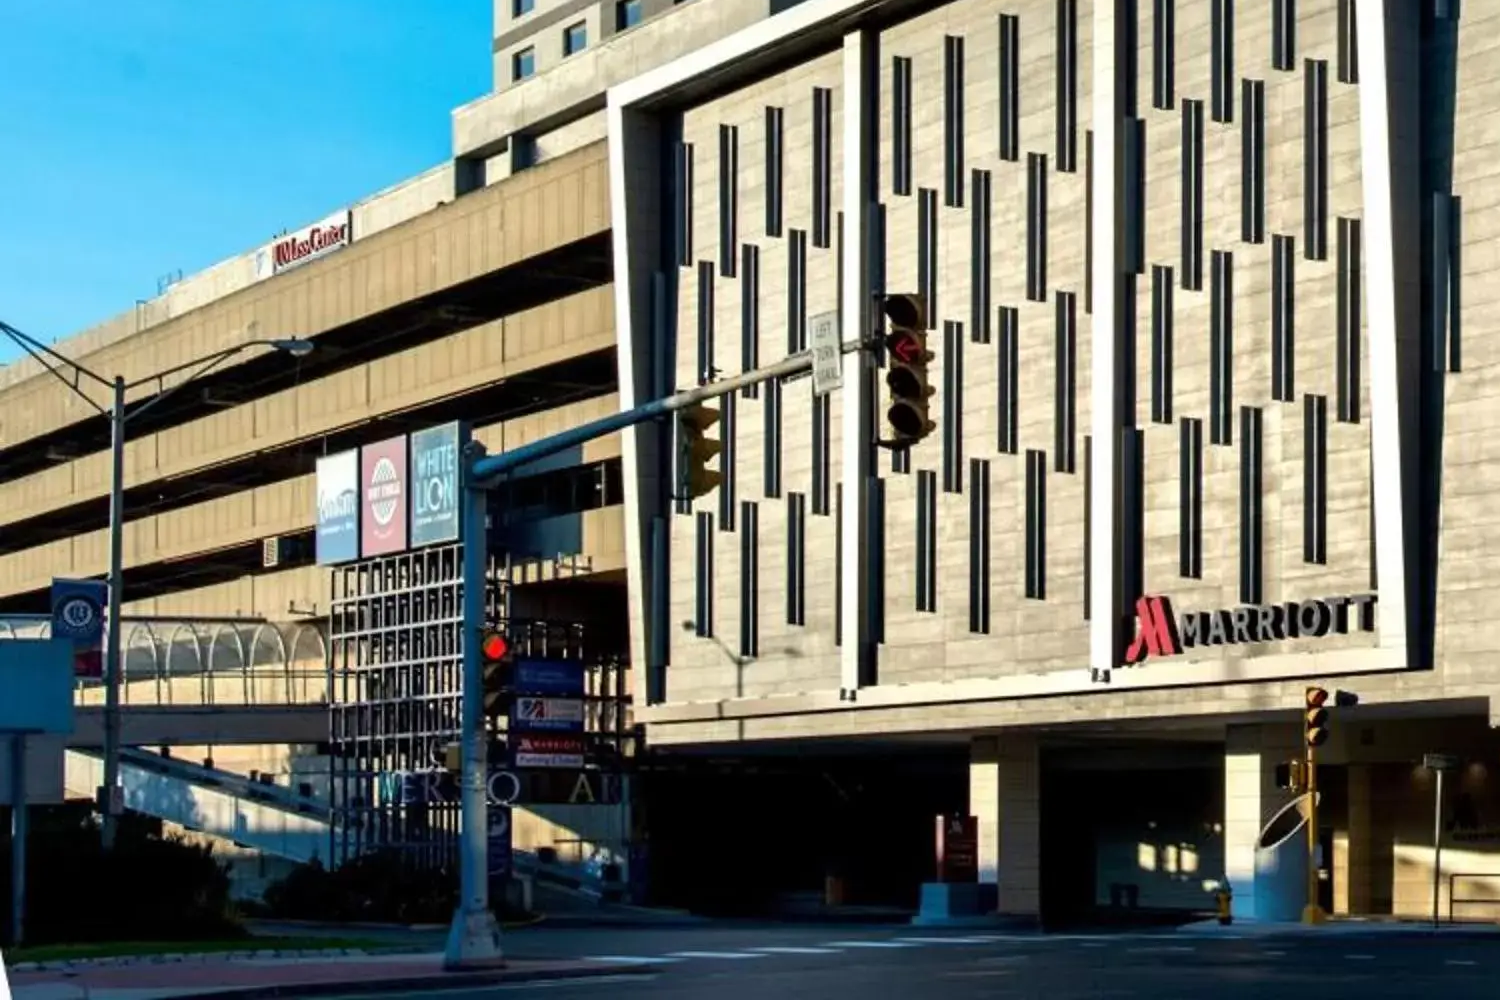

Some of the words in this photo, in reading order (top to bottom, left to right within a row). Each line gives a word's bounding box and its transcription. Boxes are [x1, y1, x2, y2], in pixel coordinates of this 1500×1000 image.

[417, 444, 453, 477] WHITE
[415, 473, 454, 514] LION
[1179, 594, 1378, 647] MARRIOTT
